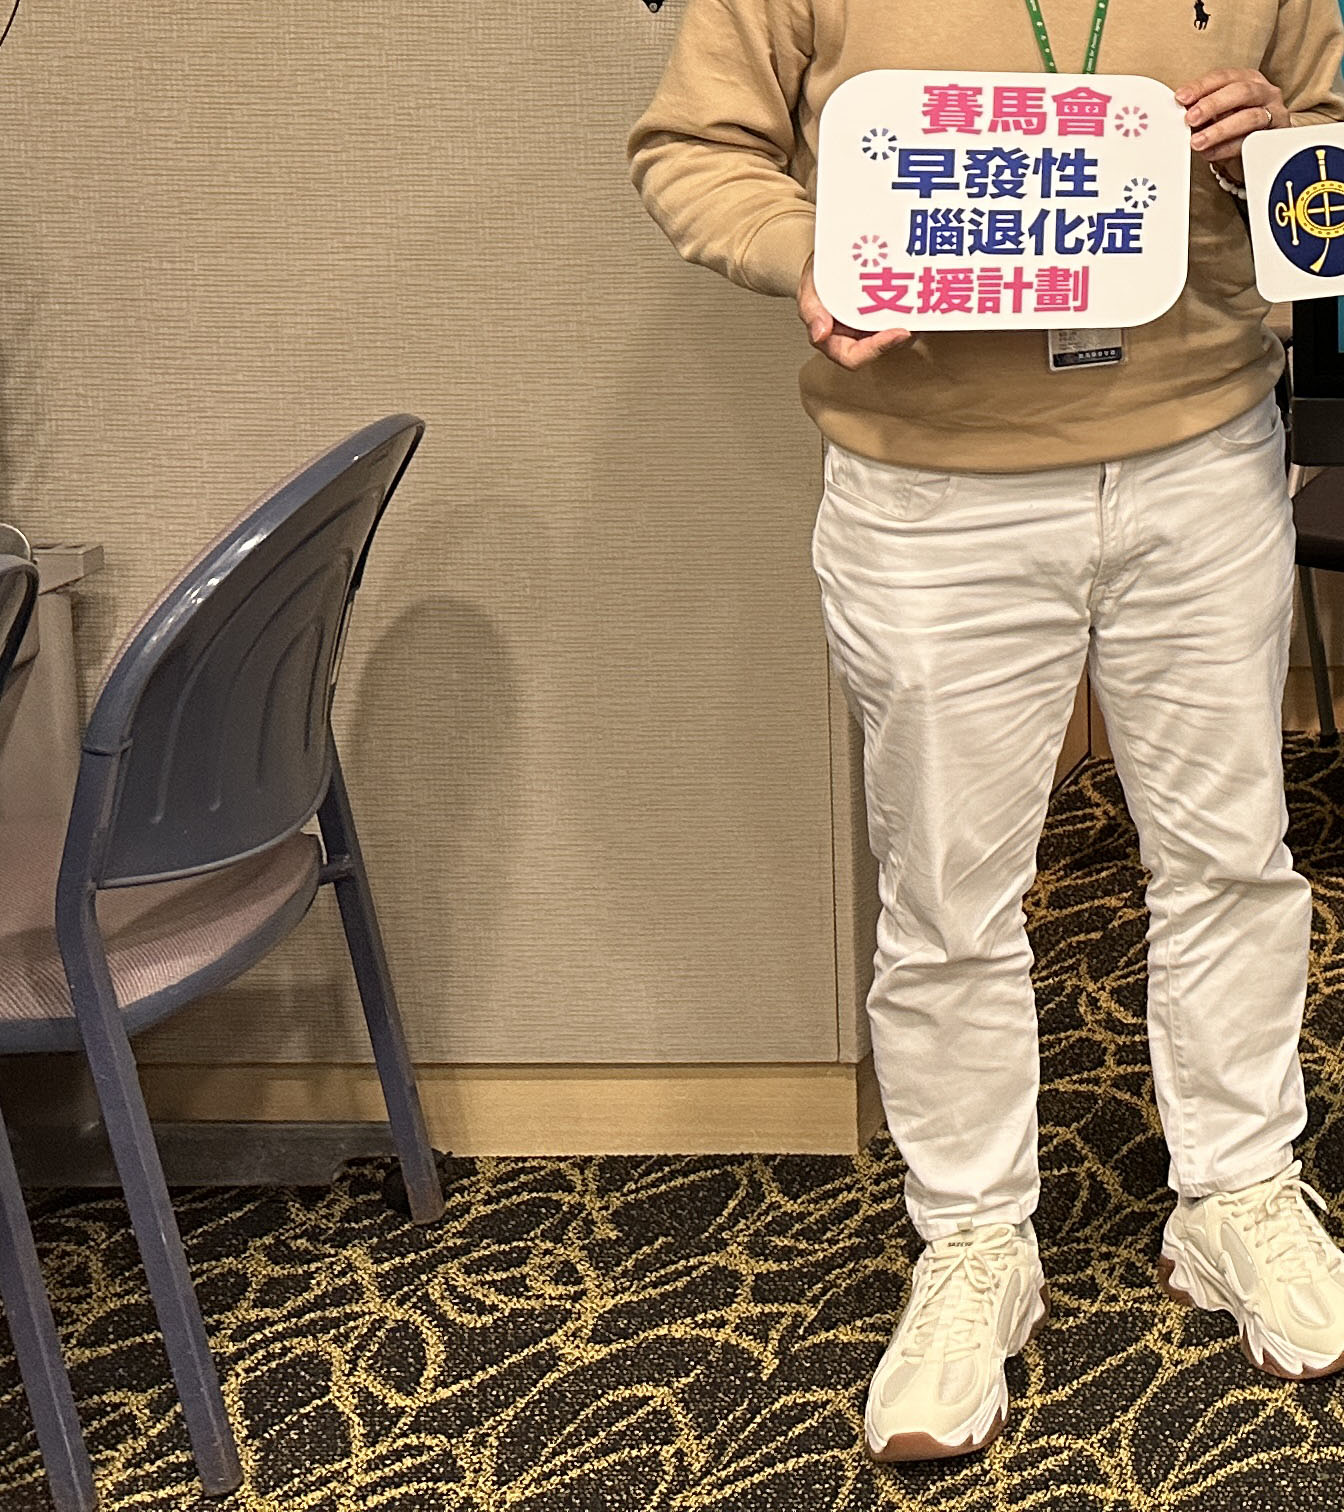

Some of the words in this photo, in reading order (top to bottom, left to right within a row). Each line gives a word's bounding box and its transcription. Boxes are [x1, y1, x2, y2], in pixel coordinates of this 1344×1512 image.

[921, 83, 1112, 137] 賽馬會
[891, 146, 1099, 199] 早發性
[906, 207, 1144, 257] 腦退化症
[856, 265, 1091, 316] 支援計劃
